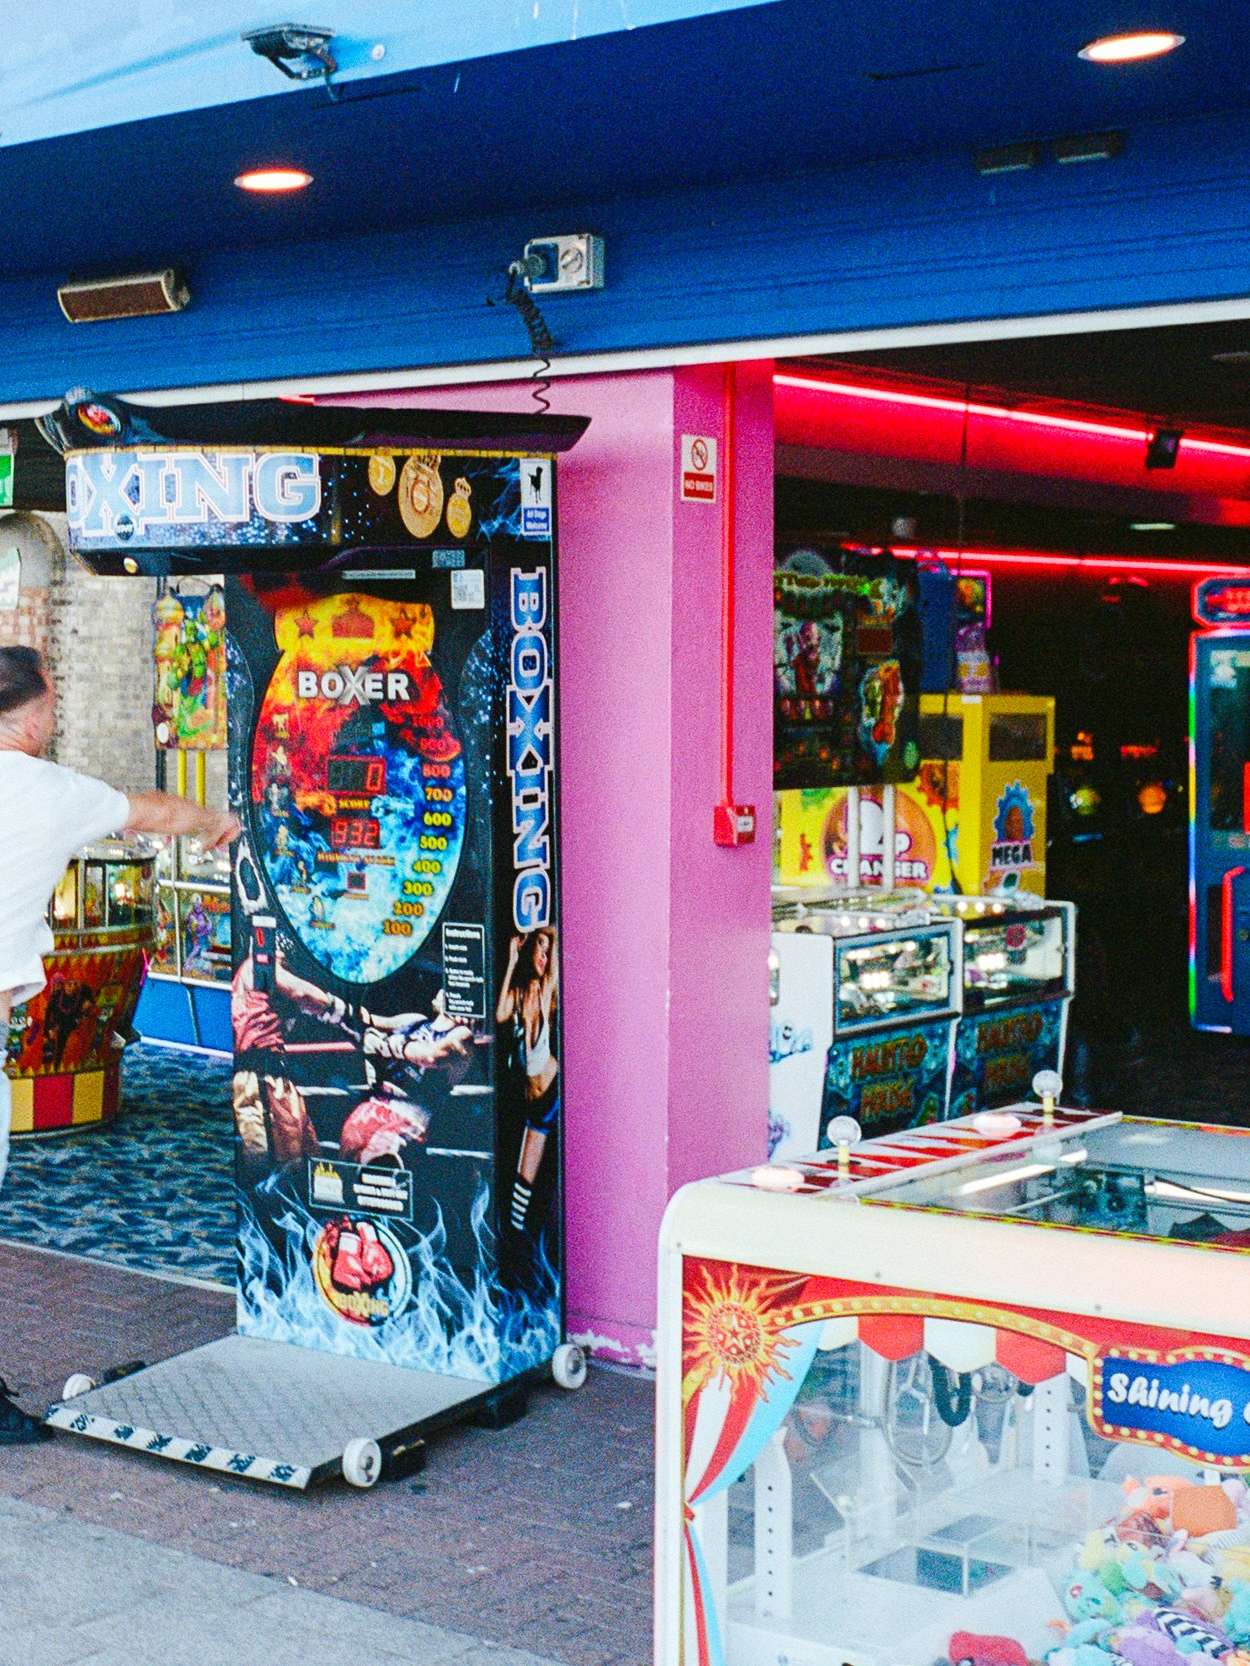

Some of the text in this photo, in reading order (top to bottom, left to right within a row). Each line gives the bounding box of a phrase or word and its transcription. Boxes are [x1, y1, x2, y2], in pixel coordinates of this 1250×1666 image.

[297, 664, 411, 706] BOXER
[506, 566, 553, 933] BOXING
[422, 763, 451, 779] 800
[425, 786, 453, 803] 700
[423, 811, 452, 827] 600
[332, 820, 379, 846] 932
[419, 834, 448, 851] 500
[991, 844, 1032, 867] MEGA
[412, 859, 442, 874] 400
[403, 880, 434, 897] 300
[393, 901, 424, 917] 200
[383, 919, 412, 936] 100
[1107, 1372, 1234, 1430] Shining
